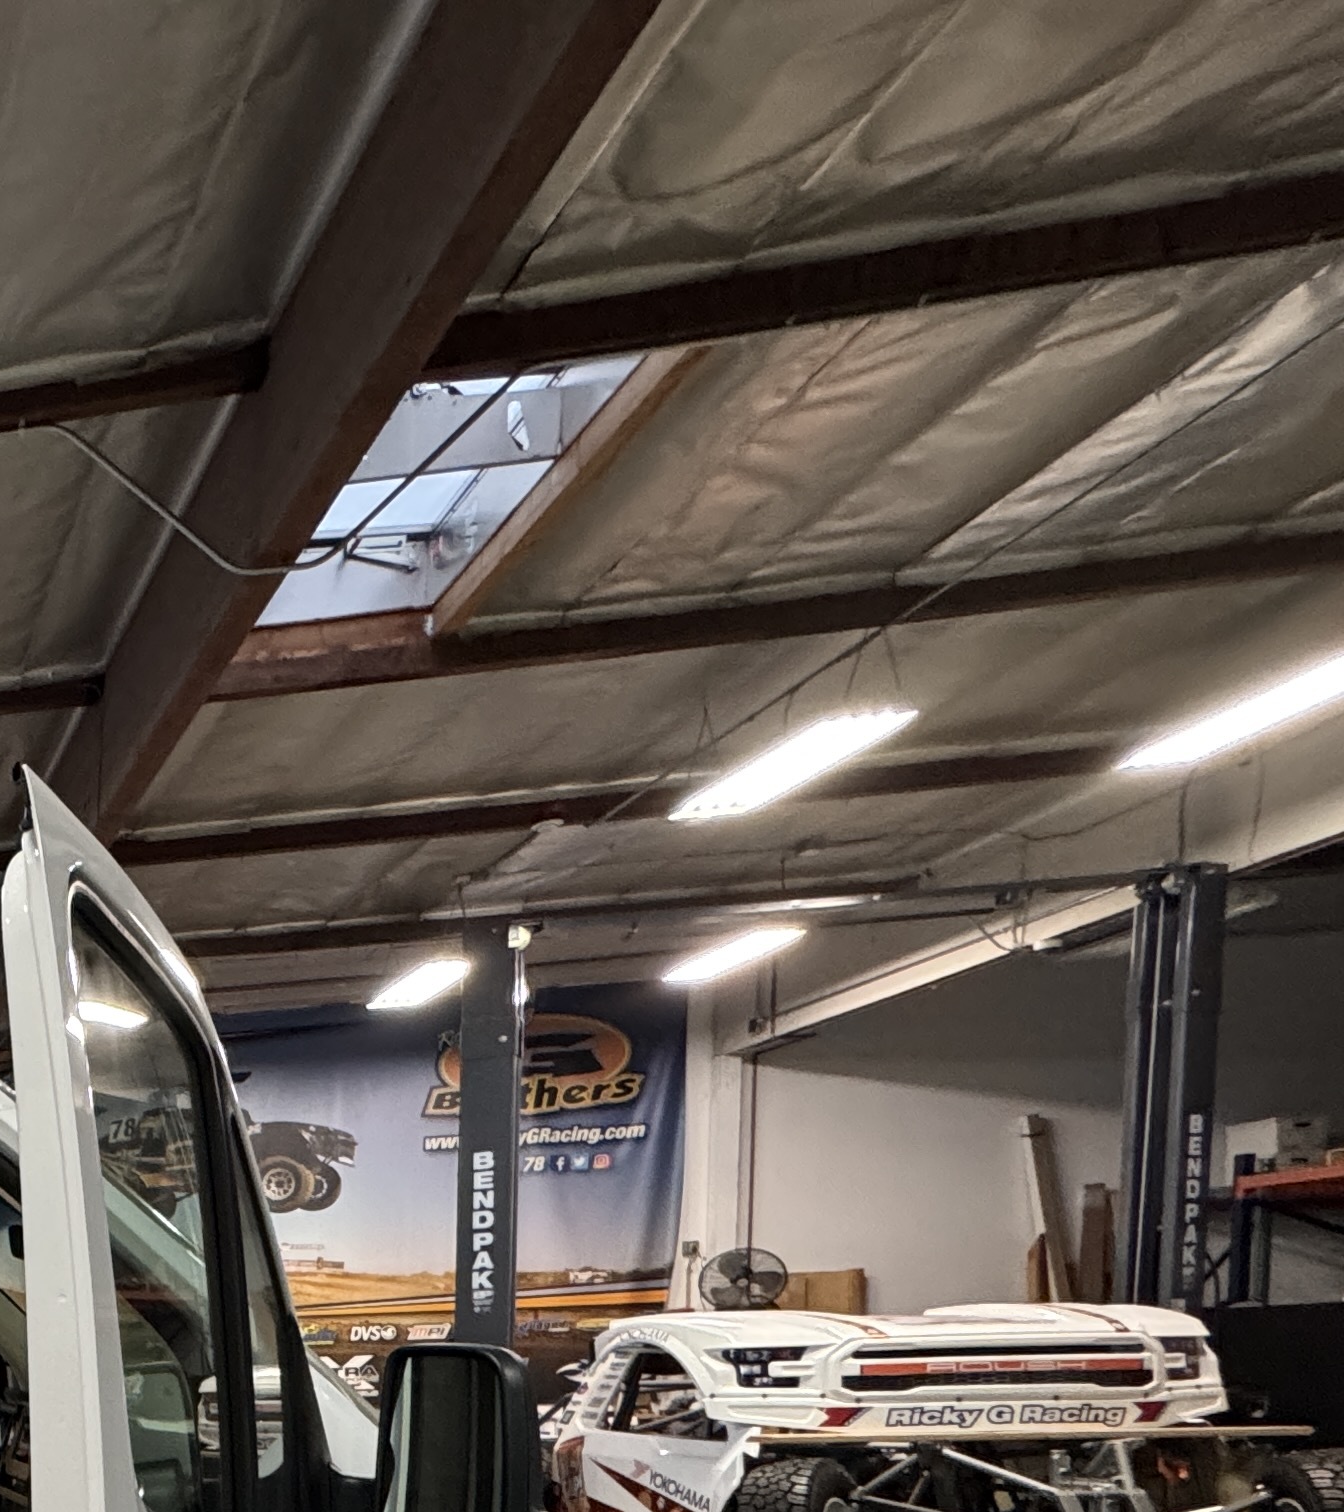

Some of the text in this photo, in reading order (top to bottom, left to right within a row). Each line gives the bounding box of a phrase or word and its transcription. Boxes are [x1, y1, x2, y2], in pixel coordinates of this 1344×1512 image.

[428, 1076, 639, 1112] Bthers
[1182, 1113, 1204, 1265] BENDPAK
[472, 1151, 495, 1290] BENDPAK
[349, 1325, 381, 1341] DVS
[885, 1403, 1128, 1428] Ricky G Racing
